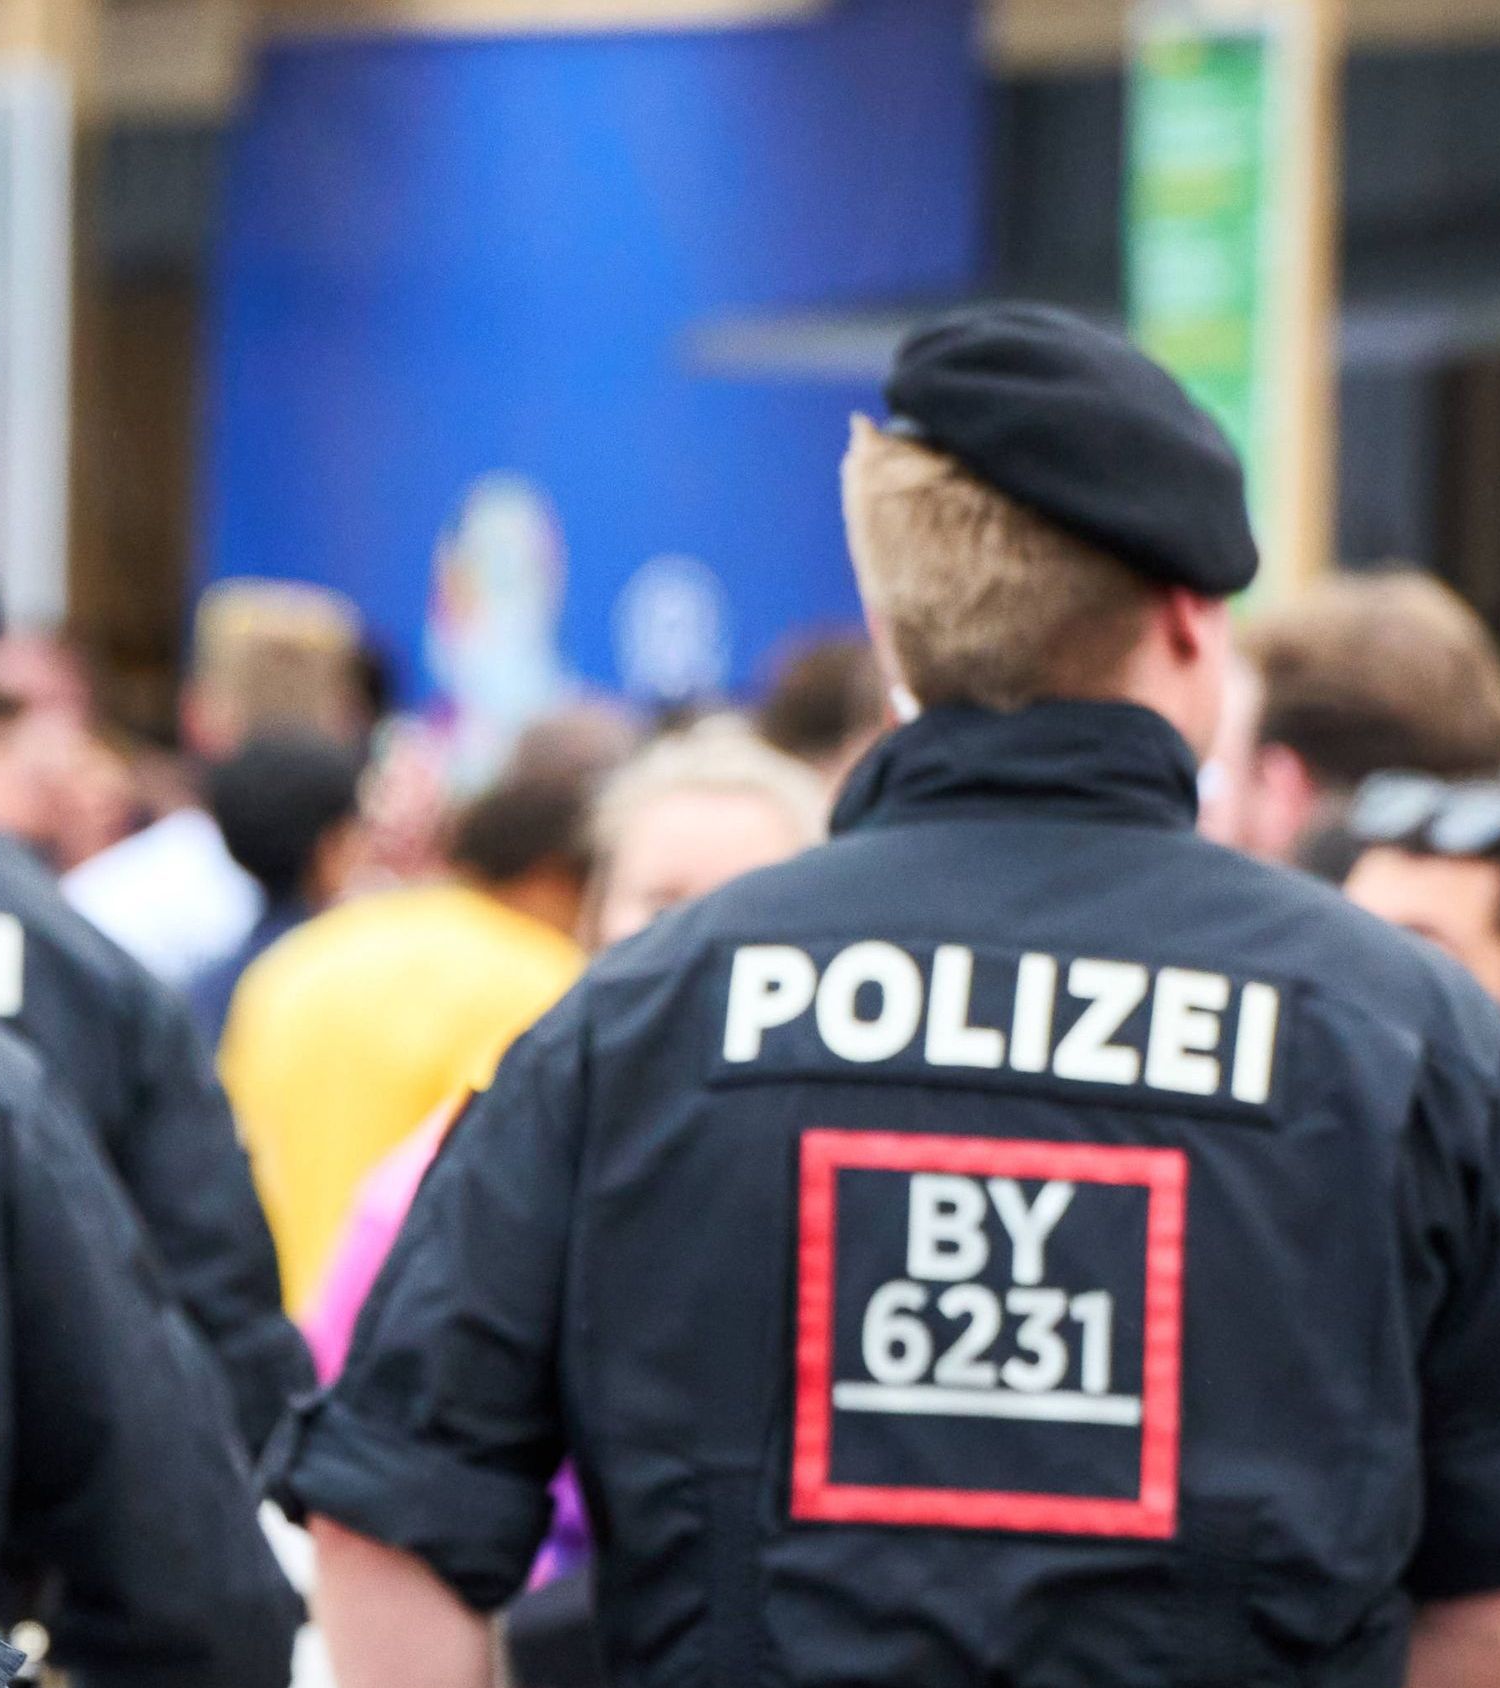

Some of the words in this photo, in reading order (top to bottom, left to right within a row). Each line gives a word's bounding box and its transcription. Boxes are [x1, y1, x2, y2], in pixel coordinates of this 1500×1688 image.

[723, 940, 1278, 1104] POLIZEI
[906, 1171, 1076, 1286] BY
[861, 1279, 1113, 1394] 6231
